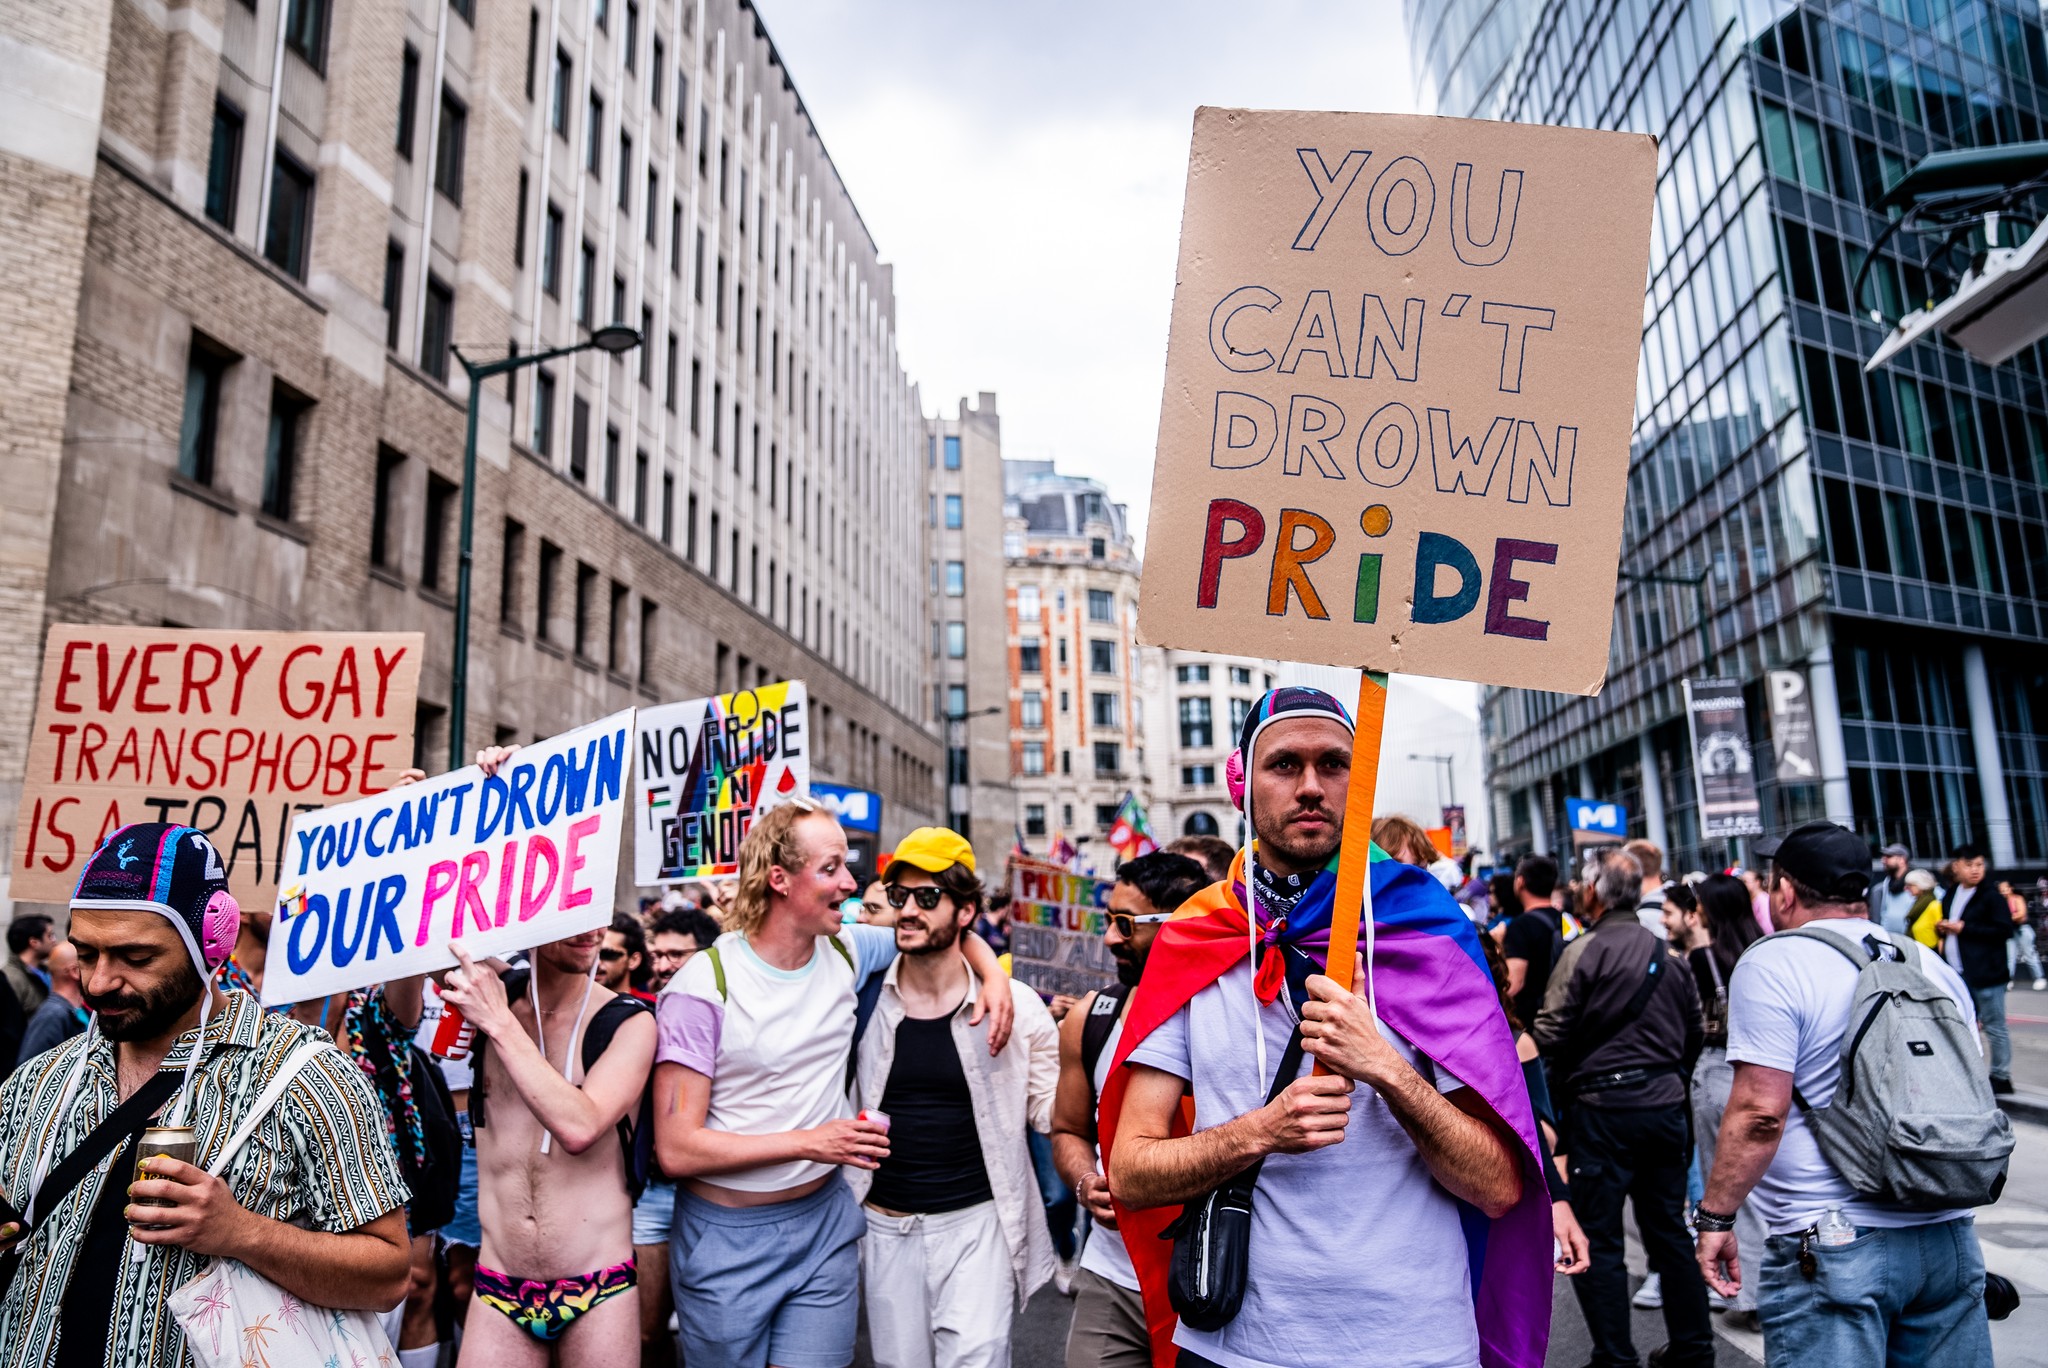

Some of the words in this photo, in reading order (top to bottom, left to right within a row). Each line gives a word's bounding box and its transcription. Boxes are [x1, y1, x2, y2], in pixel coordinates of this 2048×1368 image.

[1292, 148, 1524, 267] YOU
[1209, 285, 1556, 394] CAN'T
[1211, 391, 1578, 507] DROWN
[55, 641, 263, 716] EVERY
[279, 645, 408, 723] GAY
[1770, 670, 1805, 715] P
[48, 722, 398, 796] TRANSPHOBE
[642, 726, 690, 780] NO
[24, 797, 82, 873] IS
[298, 818, 362, 875] YOU
[365, 783, 473, 857] CAN'T
[475, 729, 626, 844] DROWN
[190, 834, 225, 881] 2
[286, 874, 407, 975] OUR
[415, 815, 601, 947] PRIDE
[1022, 870, 1116, 909] PROTEC
